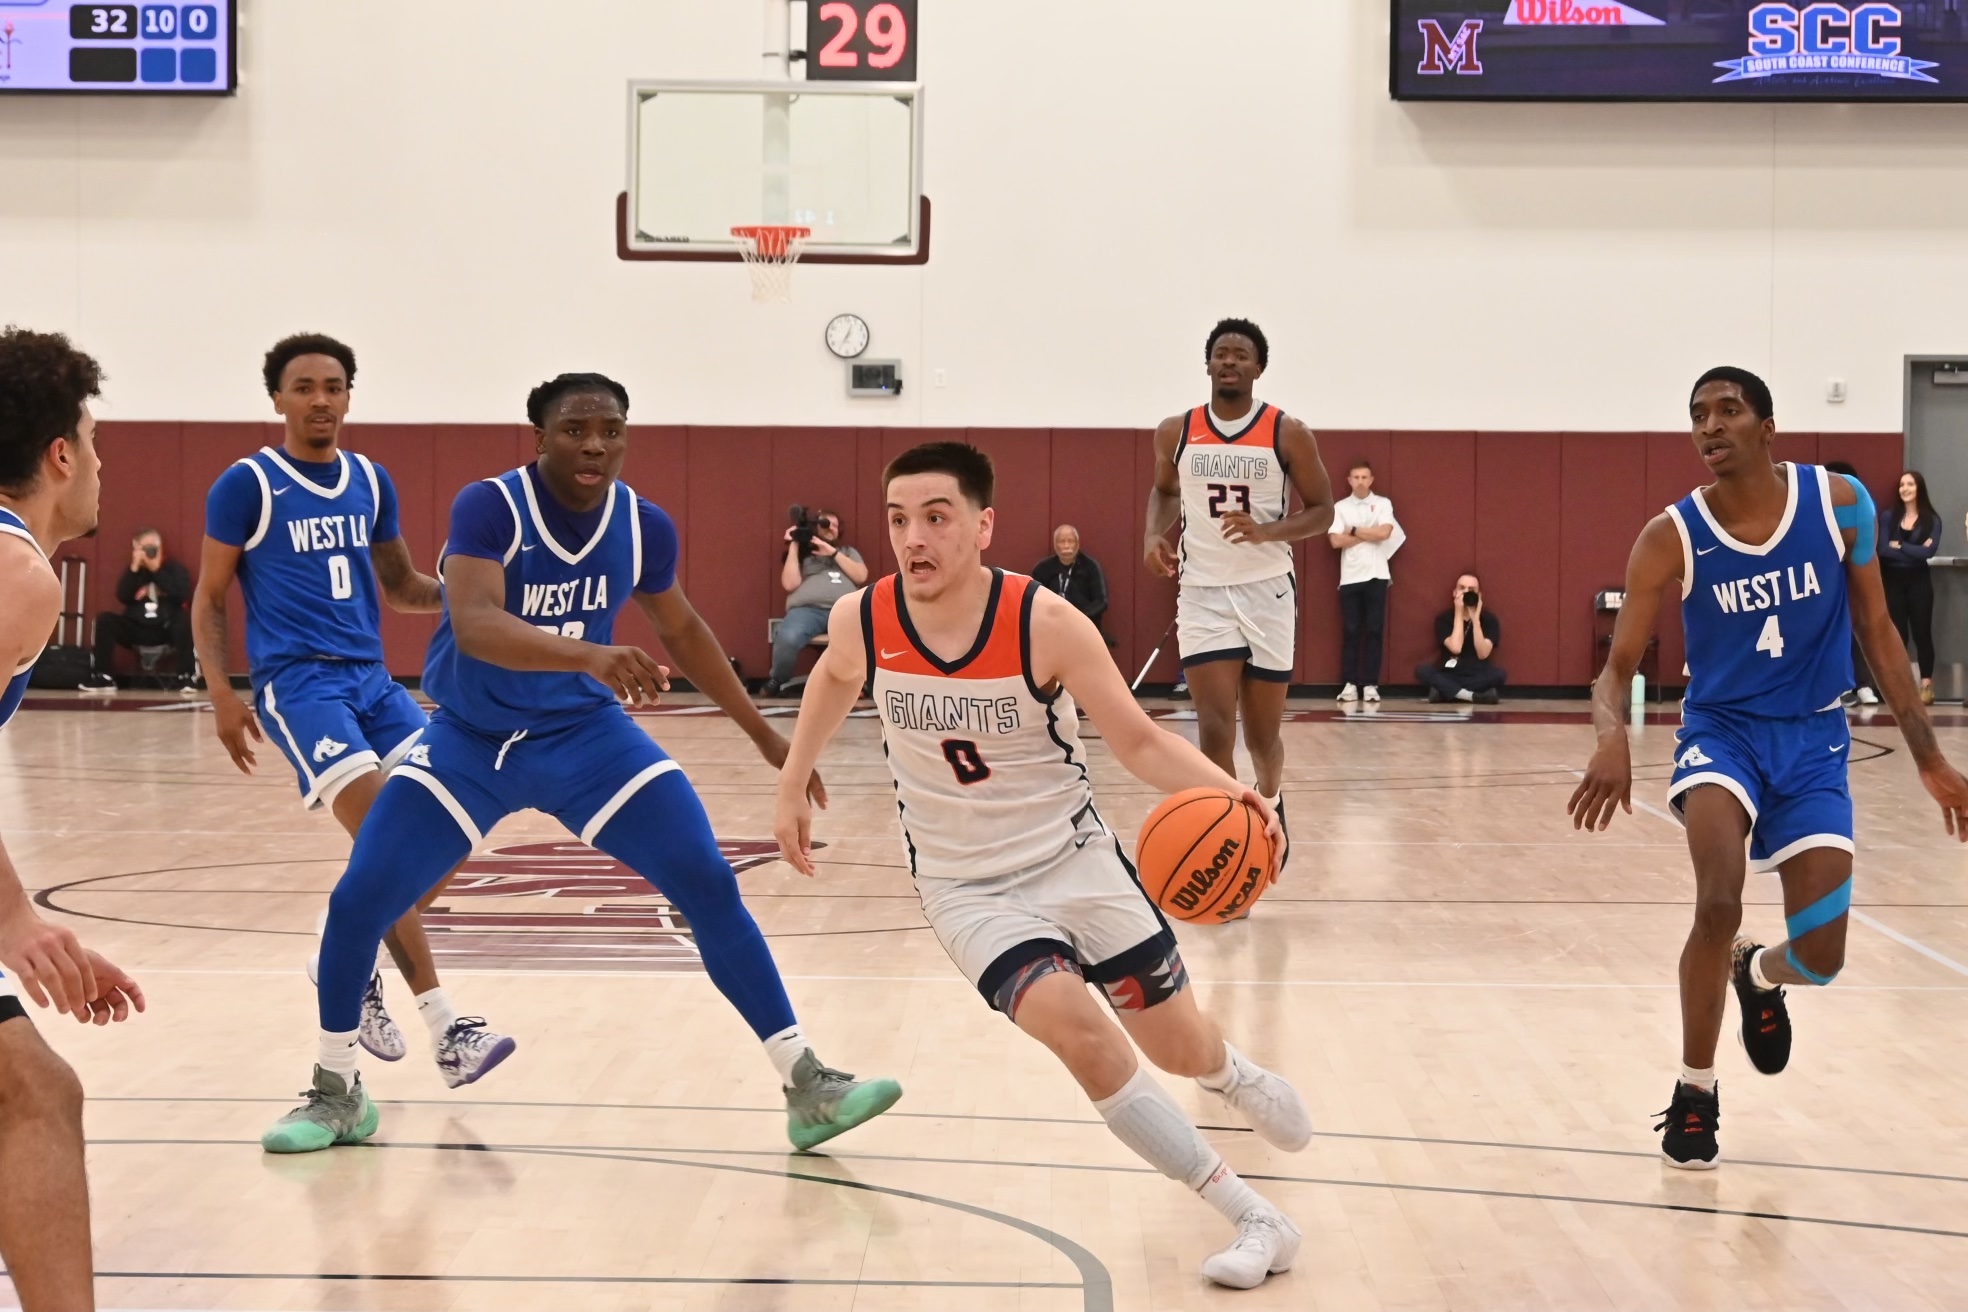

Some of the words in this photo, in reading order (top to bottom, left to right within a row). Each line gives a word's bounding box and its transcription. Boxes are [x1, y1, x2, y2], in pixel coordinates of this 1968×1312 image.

[91, 9, 128, 33] 32
[145, 9, 175, 33] 10
[188, 9, 209, 33] 0
[819, 2, 907, 68] 29
[1515, 0, 1623, 25] Wilson
[1748, 2, 1902, 57] SCC
[1417, 19, 1484, 75] M
[1746, 56, 1788, 72] SOUTH
[1788, 55, 1829, 69] COAST
[1830, 55, 1906, 72] CONFERENCE
[1191, 453, 1268, 480] GIANTS
[1206, 483, 1251, 519] 23
[287, 515, 345, 553] WEST
[349, 514, 369, 548] LA
[328, 554, 352, 600] 0
[521, 578, 580, 617] WEST
[581, 574, 607, 611] LA
[1712, 570, 1781, 614] WEST
[1787, 561, 1821, 601] LA
[1755, 614, 1784, 659] 4
[885, 689, 1020, 735] GIANTS
[940, 738, 992, 786] 0
[1170, 838, 1241, 911] Wilson
[1216, 866, 1262, 919] NCAA
